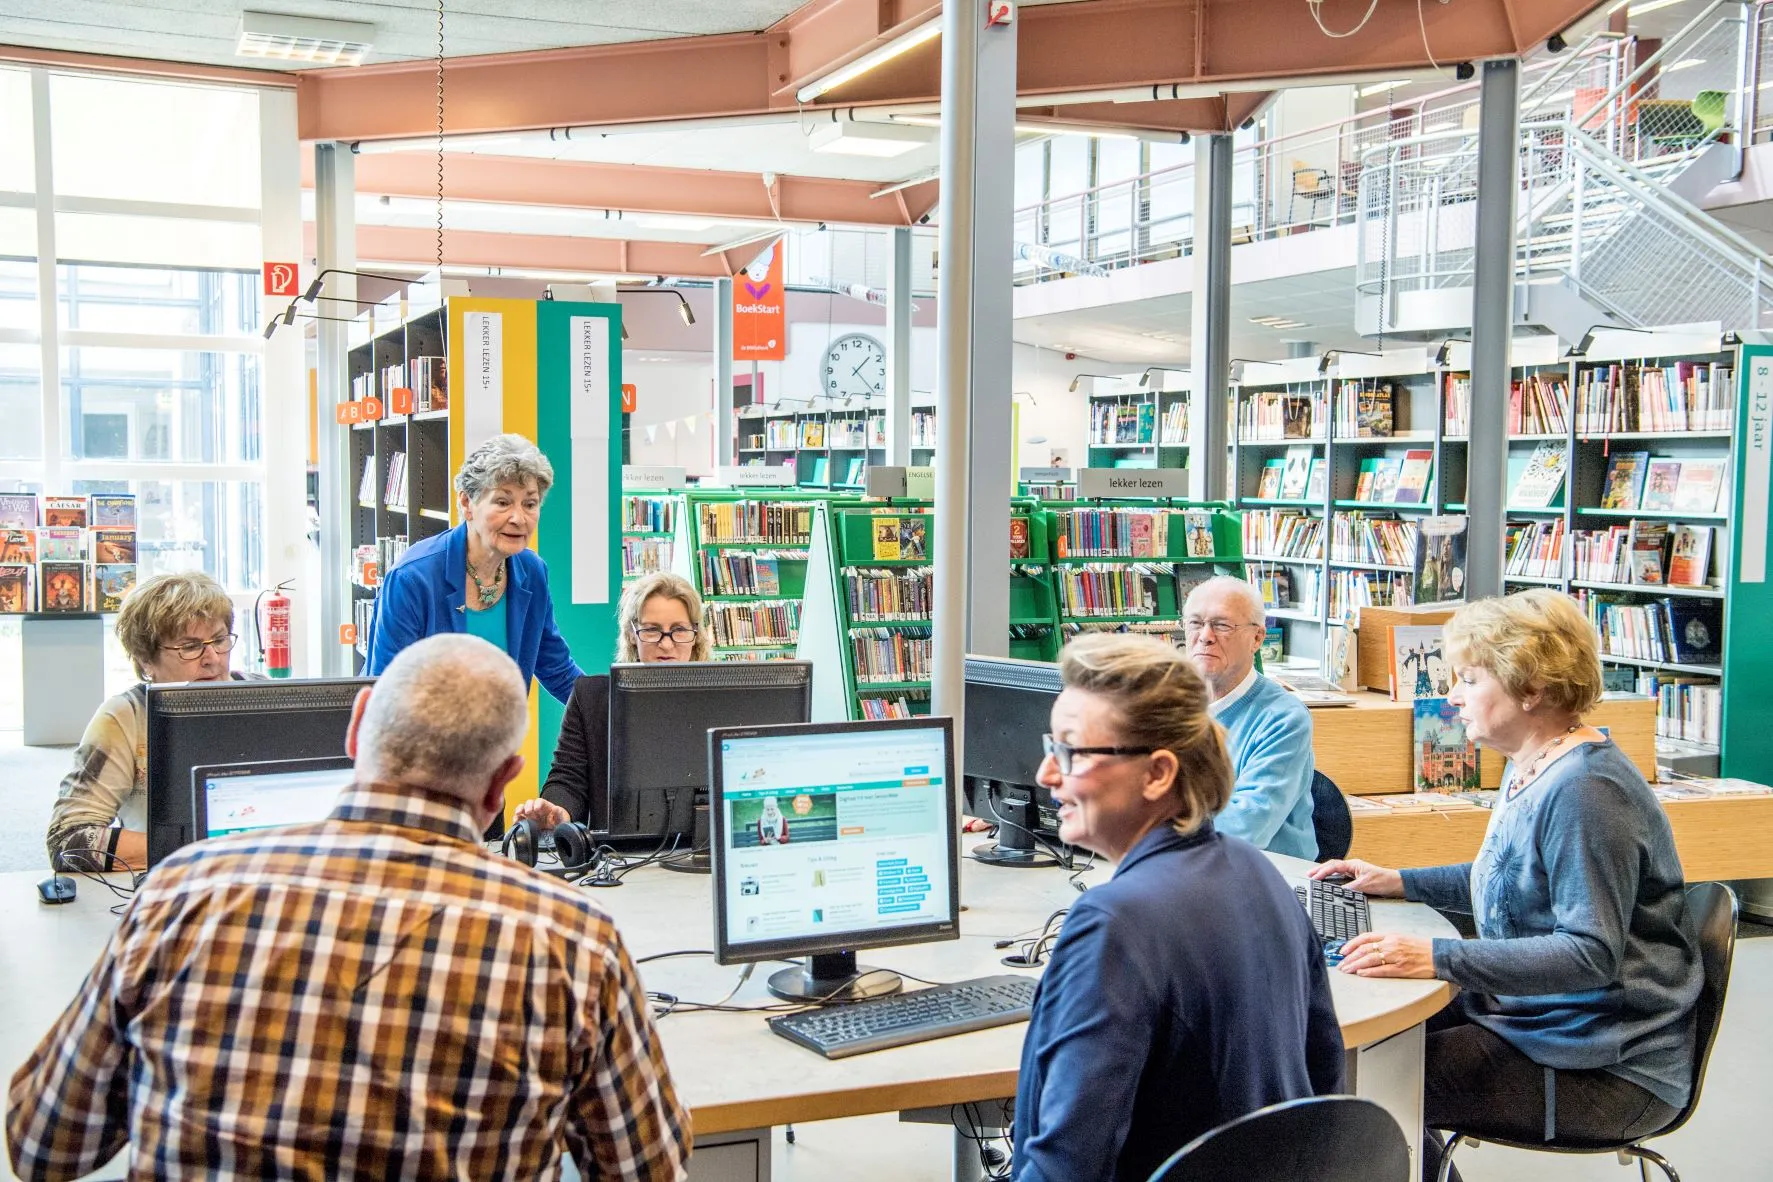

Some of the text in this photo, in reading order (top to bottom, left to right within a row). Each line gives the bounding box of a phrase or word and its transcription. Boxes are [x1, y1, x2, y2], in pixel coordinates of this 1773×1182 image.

[736, 304, 780, 314] BoekStart
[852, 340, 862, 348] 12
[482, 316, 490, 391] LEKKER LEZEN 15+
[583, 321, 592, 394] LEKKER LEZEN 15+
[831, 353, 840, 361] 10
[1758, 367, 1768, 376] 8
[401, 395, 406, 408] J
[1756, 392, 1767, 412] 12
[351, 407, 358, 418] B
[367, 403, 376, 414] D
[1752, 416, 1767, 451] jaar
[624, 473, 665, 482] ekker lezen
[739, 472, 777, 480] lekker lezen
[908, 471, 933, 479] ENGELSE
[1109, 477, 1164, 489] lekker lezen
[1014, 526, 1020, 535] 2
[345, 629, 352, 640] C
